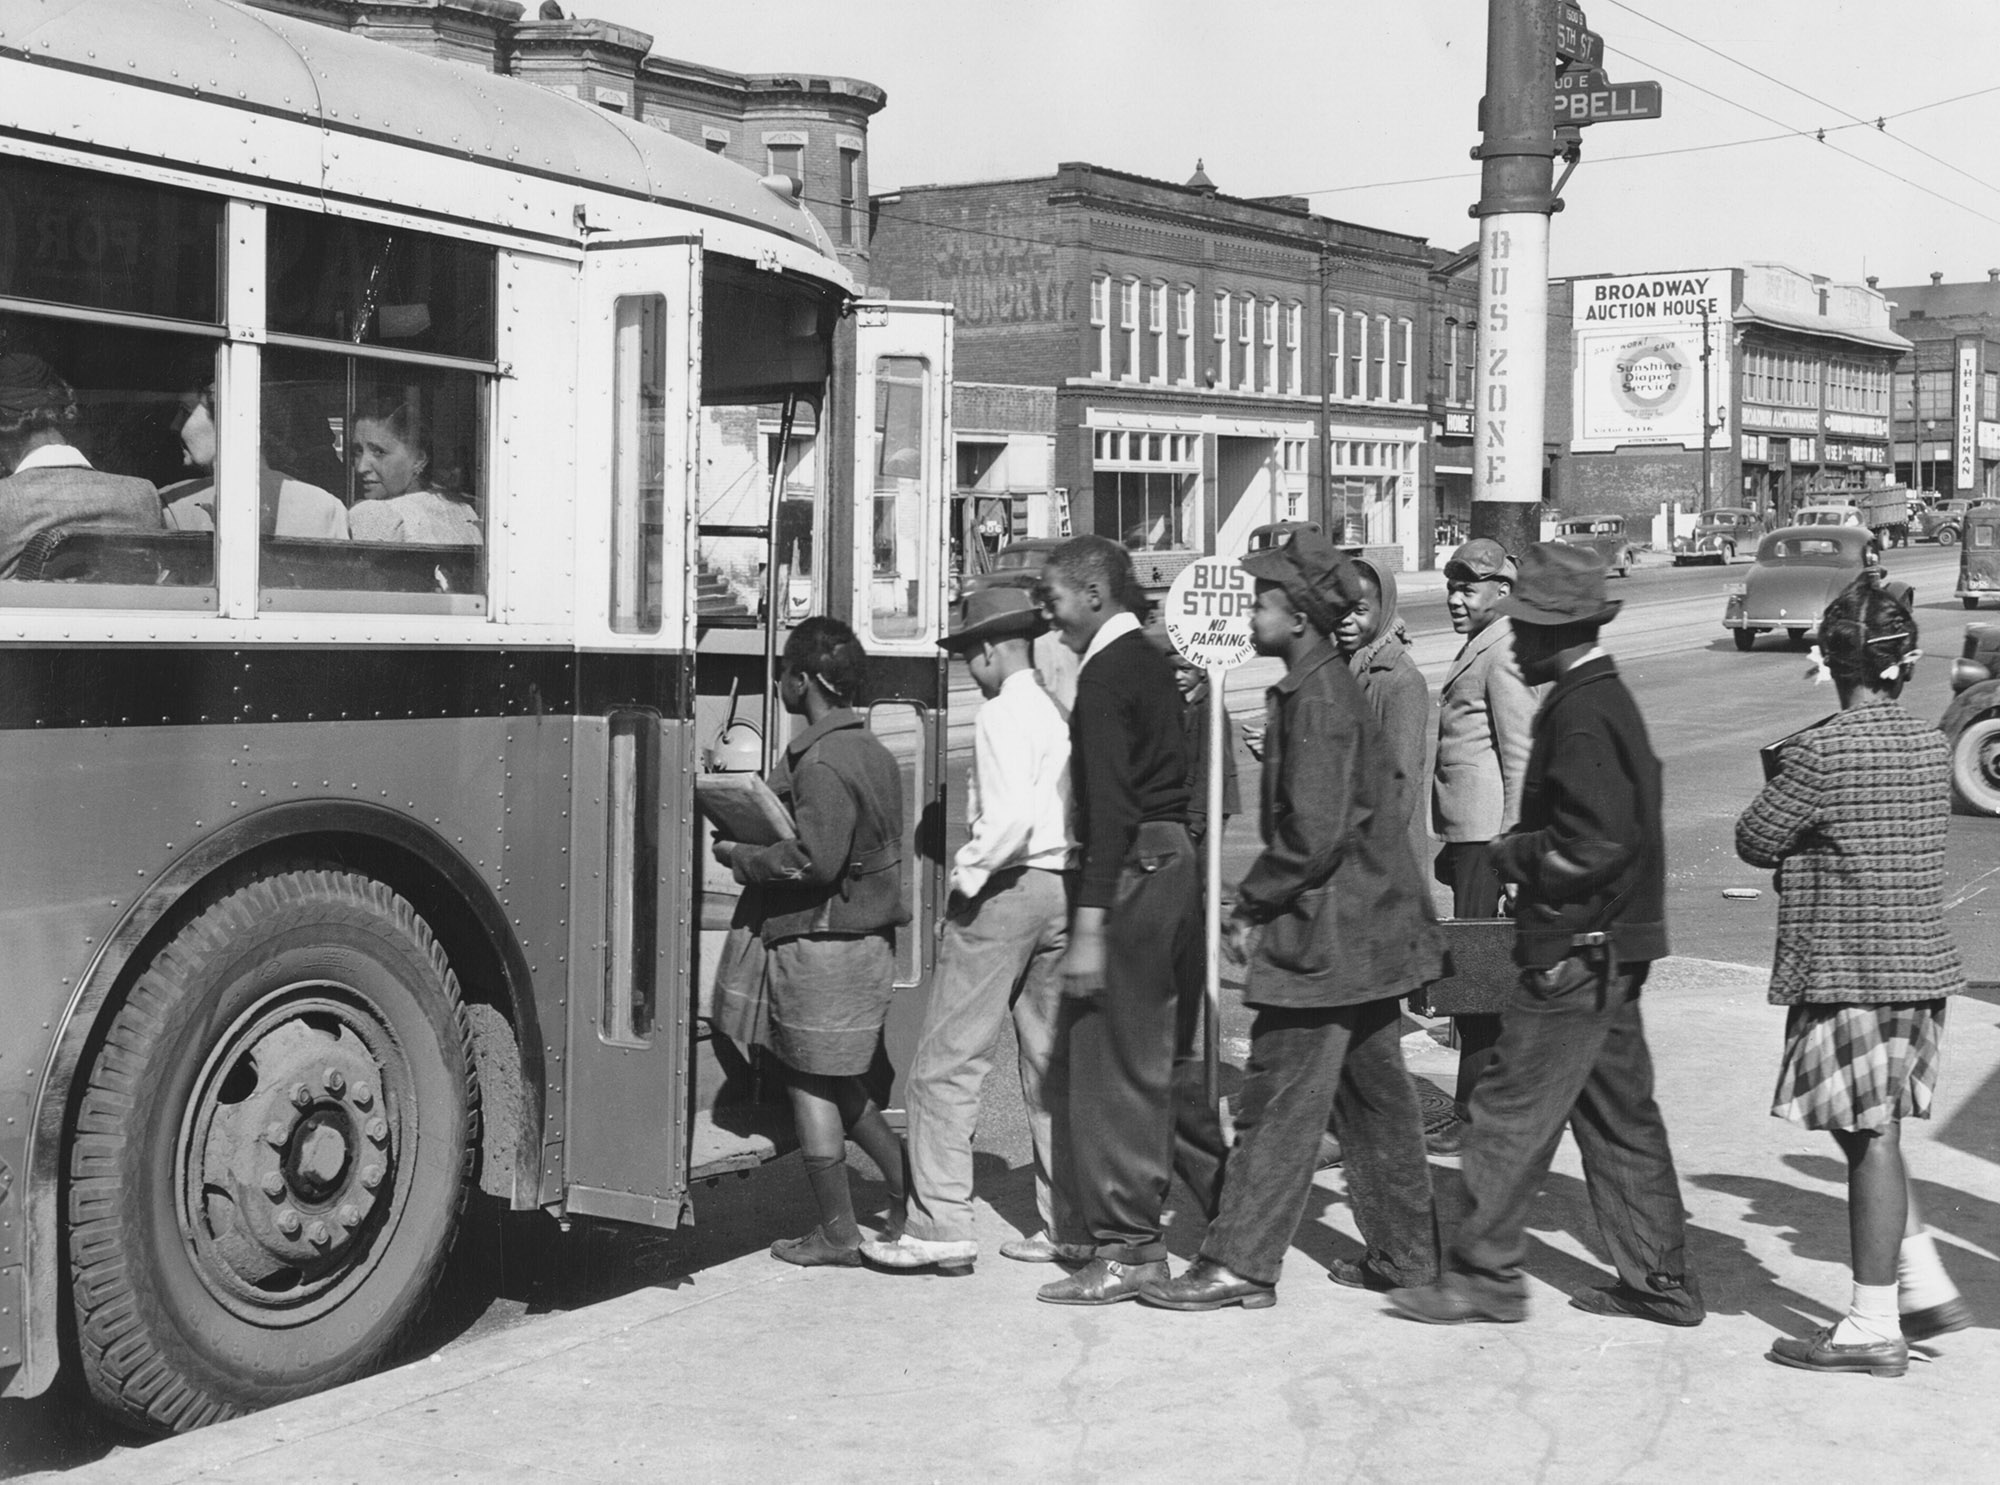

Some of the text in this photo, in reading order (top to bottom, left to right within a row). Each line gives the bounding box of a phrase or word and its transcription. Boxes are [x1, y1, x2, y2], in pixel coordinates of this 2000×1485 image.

[1579, 75, 1589, 88] E
[1490, 230, 1510, 332] BUS
[1594, 277, 1711, 301] BROADWAY
[1585, 298, 1718, 321] AUCTION HOUSE
[1653, 341, 1676, 352] SAVE
[1616, 361, 1683, 373] Sunshine
[1625, 368, 1673, 383] Diaper
[1963, 359, 1973, 388] THE
[1622, 382, 1677, 393] Service
[1446, 413, 1470, 433] HOME
[1486, 349, 1508, 485] ZONE
[1962, 394, 1972, 475] IRISHMAN
[1193, 564, 1245, 590] BUS
[1183, 591, 1253, 617] STOP
[1208, 619, 1228, 632] NO
[1190, 632, 1247, 647] PARKING
